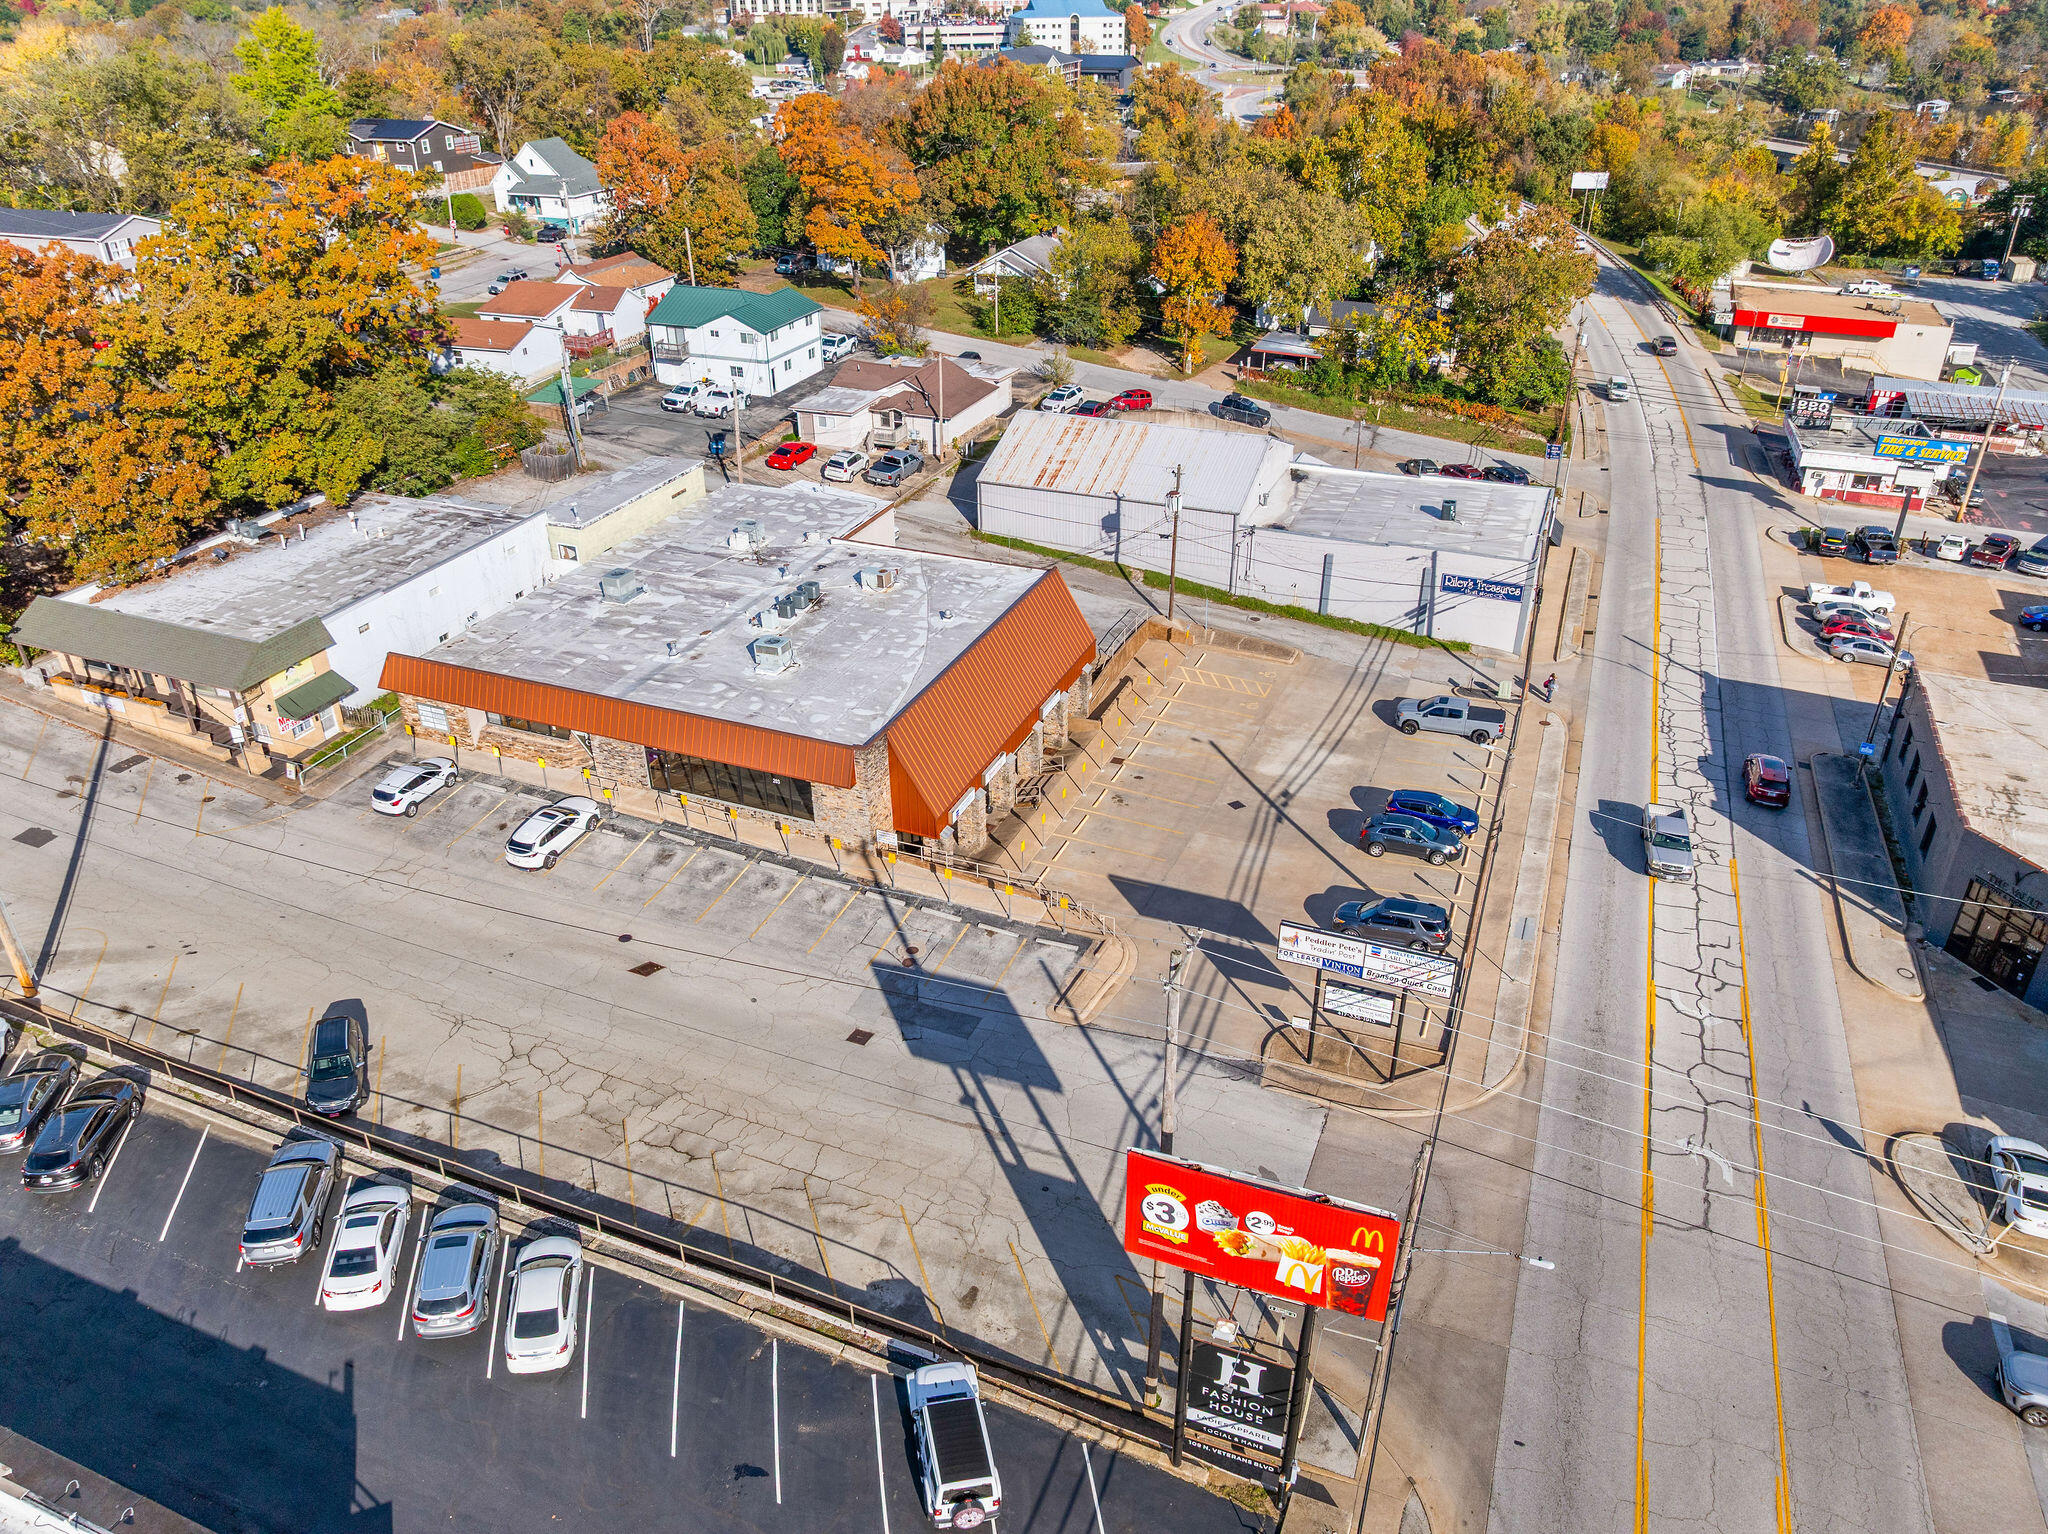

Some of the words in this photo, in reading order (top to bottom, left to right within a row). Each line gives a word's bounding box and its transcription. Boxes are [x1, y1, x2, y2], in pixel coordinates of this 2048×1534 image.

[1796, 400, 1831, 414] BBQ
[1881, 436, 1929, 447] BRANSON
[1877, 444, 1906, 456] TIRE
[1905, 446, 1917, 457] &
[1917, 447, 1967, 462] SERVICE
[1444, 575, 1474, 591] Riley's
[1476, 579, 1521, 596] Treasures
[1305, 935, 1337, 948] Peddler
[1338, 943, 1363, 954] Pete's
[1310, 944, 1337, 955] Tradin'
[1338, 951, 1356, 960] Post
[1279, 949, 1294, 957] FOR
[1296, 953, 1321, 963] LEASE
[1387, 949, 1415, 960] SHELTER
[1323, 958, 1361, 974] VINTON
[1366, 969, 1400, 984] Branson
[1401, 977, 1425, 989] Quick
[1426, 983, 1447, 993] Cash
[1151, 1186, 1182, 1199] under
[1146, 1201, 1176, 1224] $3
[1146, 1223, 1186, 1240] McVALUE
[1246, 1216, 1274, 1232] $2.99
[1333, 1267, 1368, 1284] Pepper
[1202, 1386, 1274, 1416] FASHION
[1209, 1400, 1264, 1425] HOUSE
[1196, 1413, 1230, 1427] LADIES
[1230, 1424, 1272, 1442] APPAREL
[1212, 1447, 1252, 1465] VETERANS
[1253, 1461, 1274, 1472] BLVD
